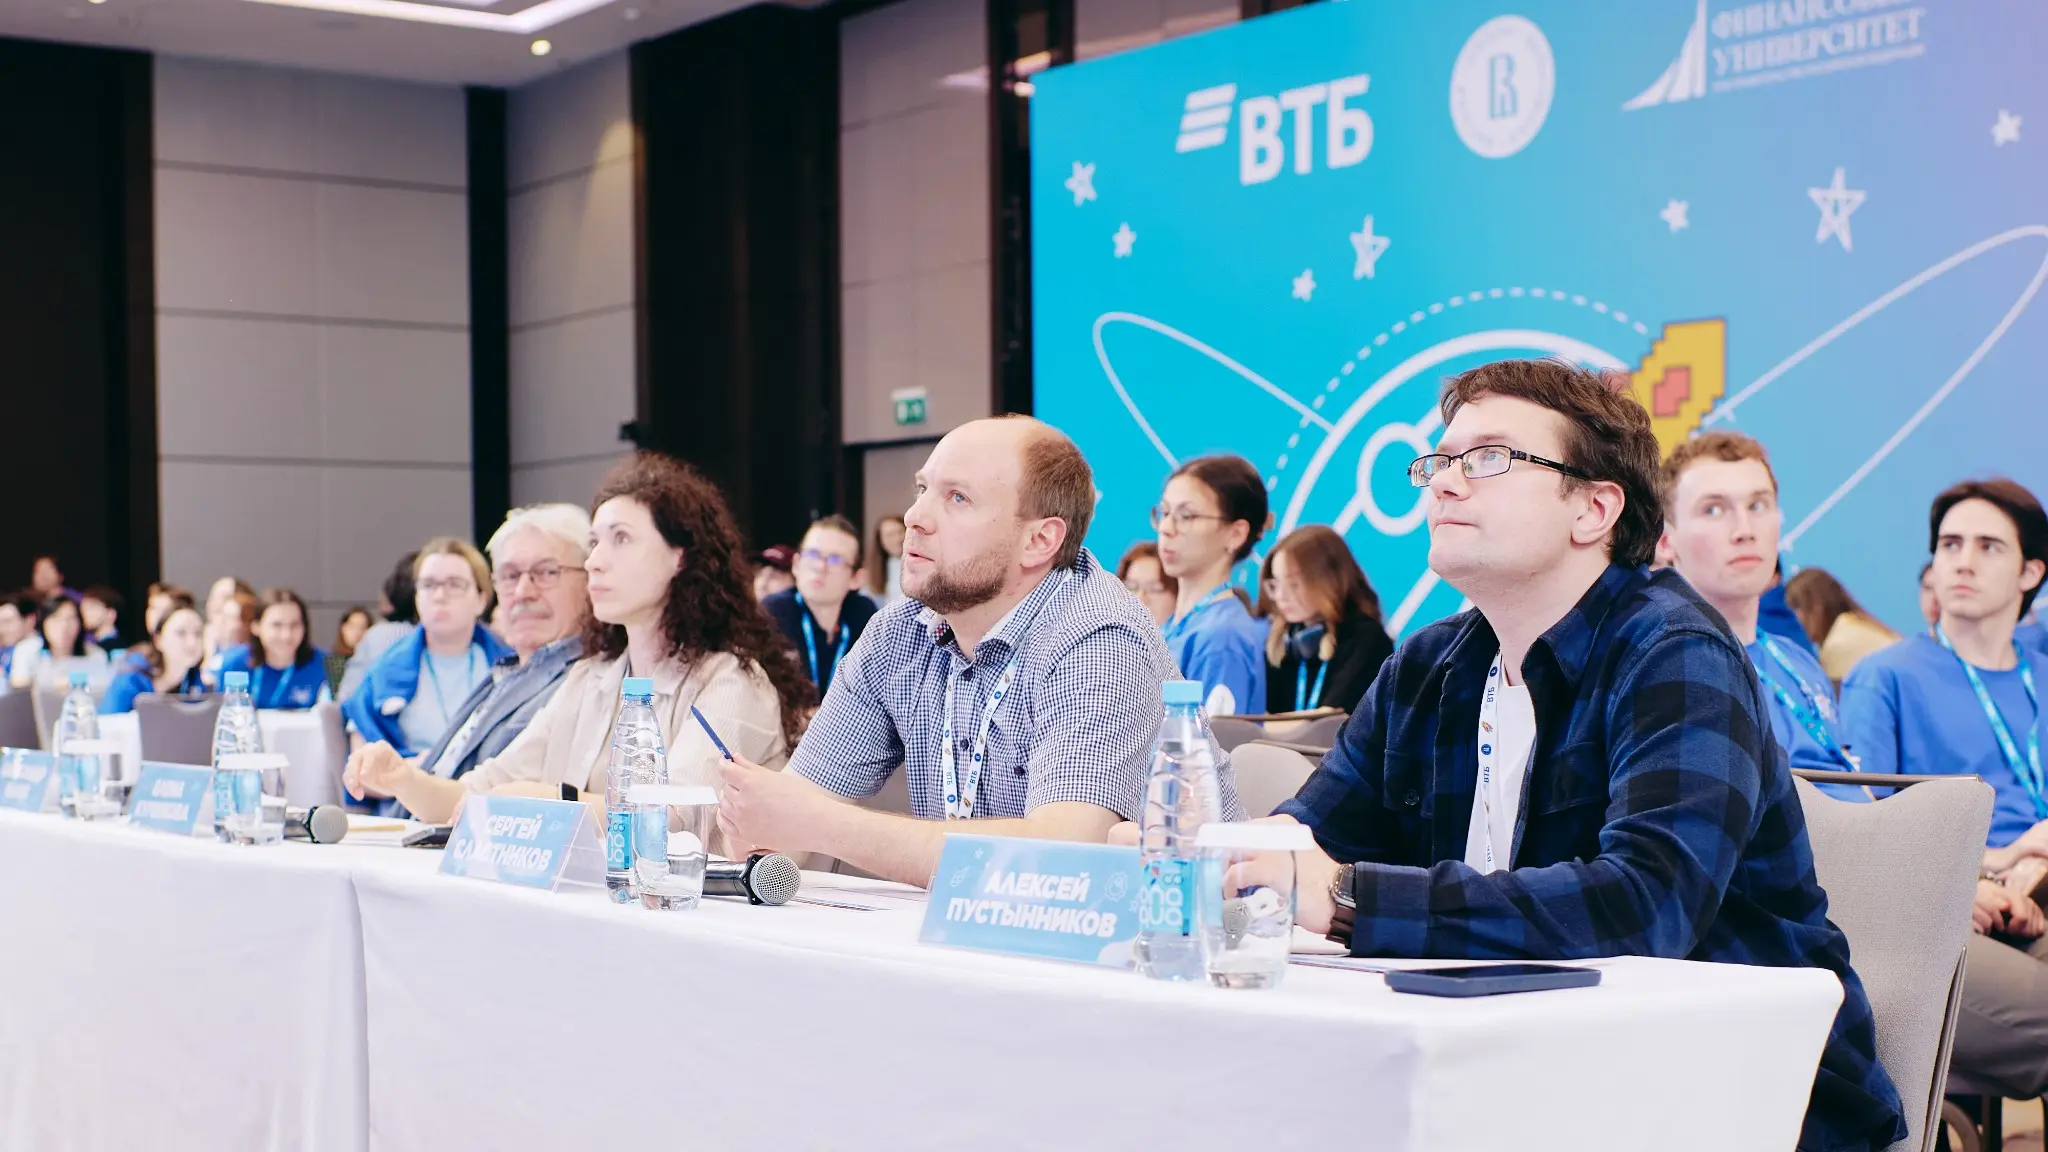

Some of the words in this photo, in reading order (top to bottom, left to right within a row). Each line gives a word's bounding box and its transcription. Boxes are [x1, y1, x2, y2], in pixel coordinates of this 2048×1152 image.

[1712, 6, 1927, 77] УНИВЕРСИТЕТ
[1239, 73, 1375, 187] ВТБ
[969, 770, 978, 785] ВТБ
[485, 813, 543, 840] СЕРГЕЙ
[985, 871, 1091, 902] АЛЕКСЕЙ
[946, 898, 1117, 938] ПУСТЫННИКОВ
